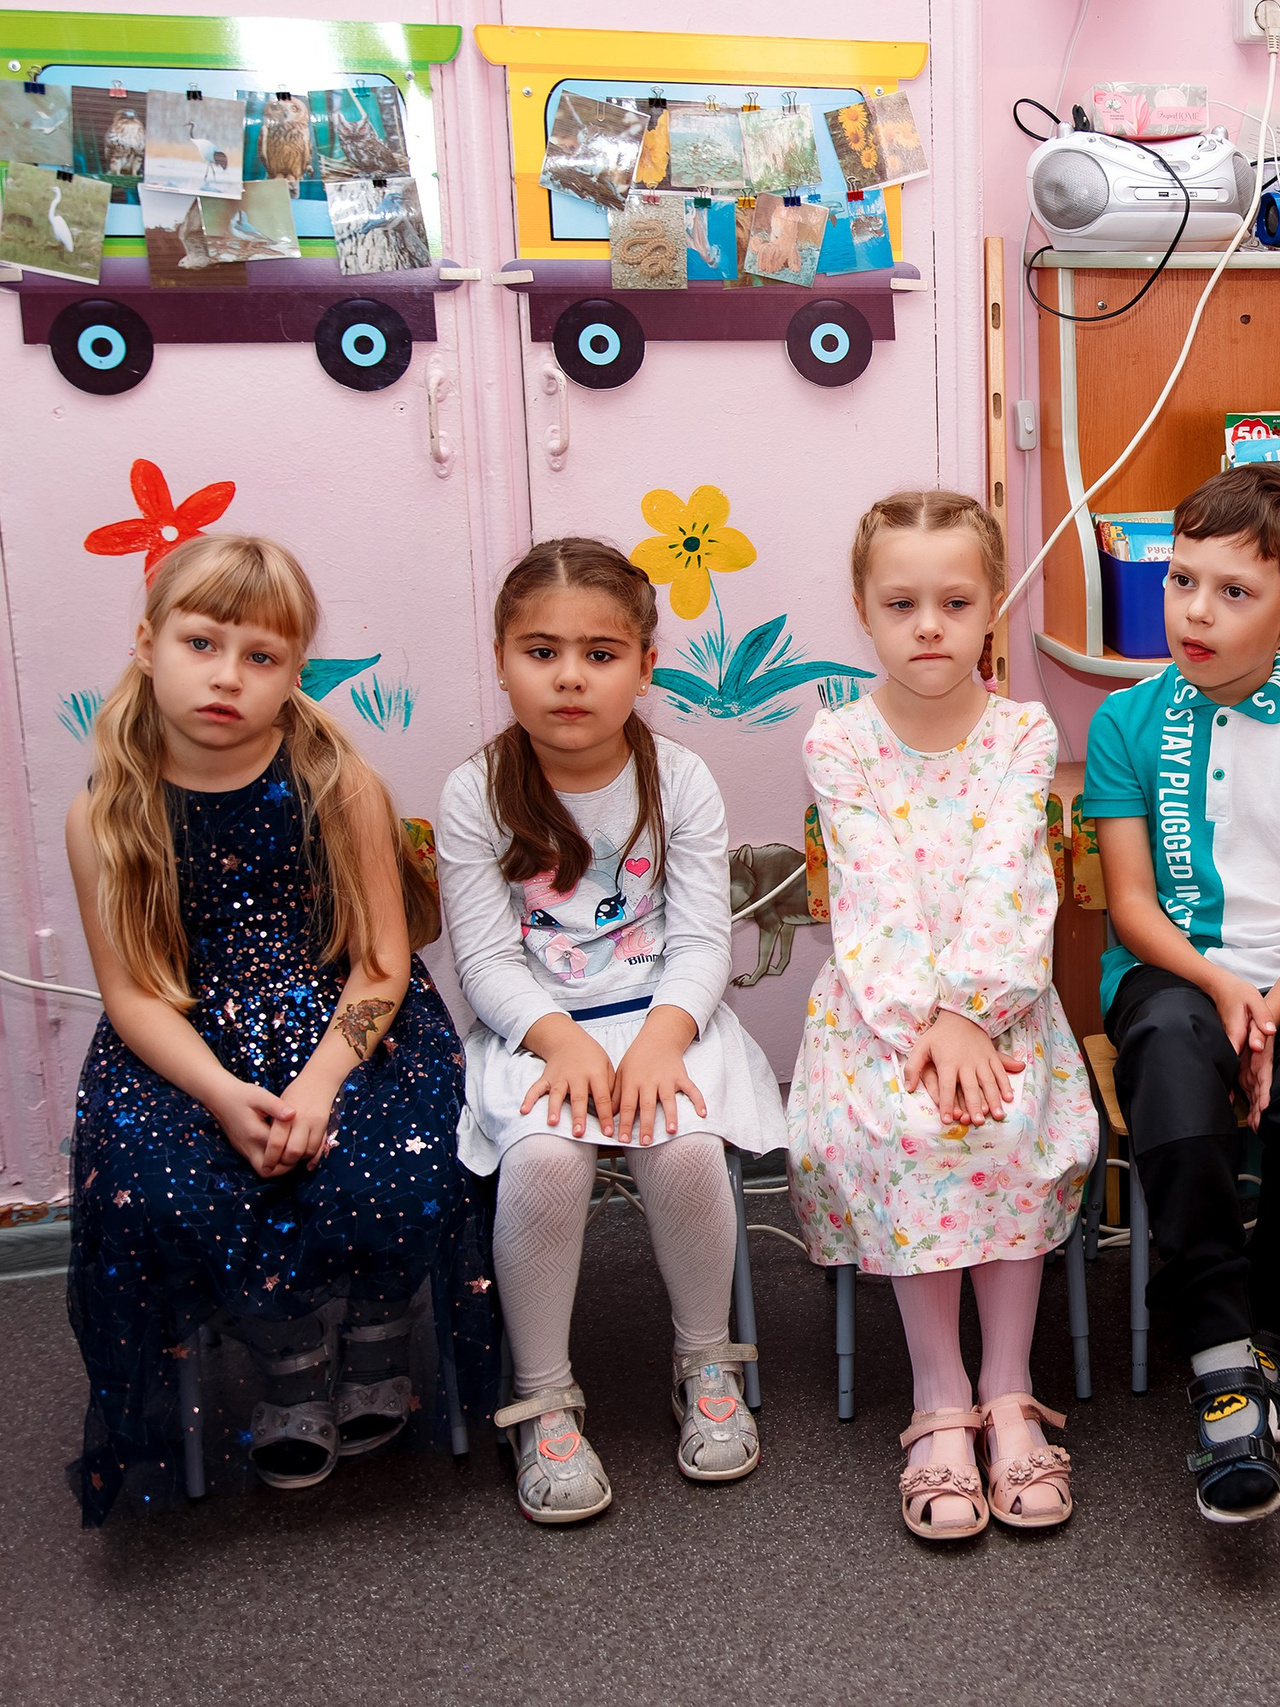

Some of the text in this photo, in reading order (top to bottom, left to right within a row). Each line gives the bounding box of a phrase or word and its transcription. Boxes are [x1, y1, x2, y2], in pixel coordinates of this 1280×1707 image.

[1237, 426, 1267, 440] 50
[1160, 707, 1194, 767] STAY
[1158, 771, 1194, 879] PLUGGED
